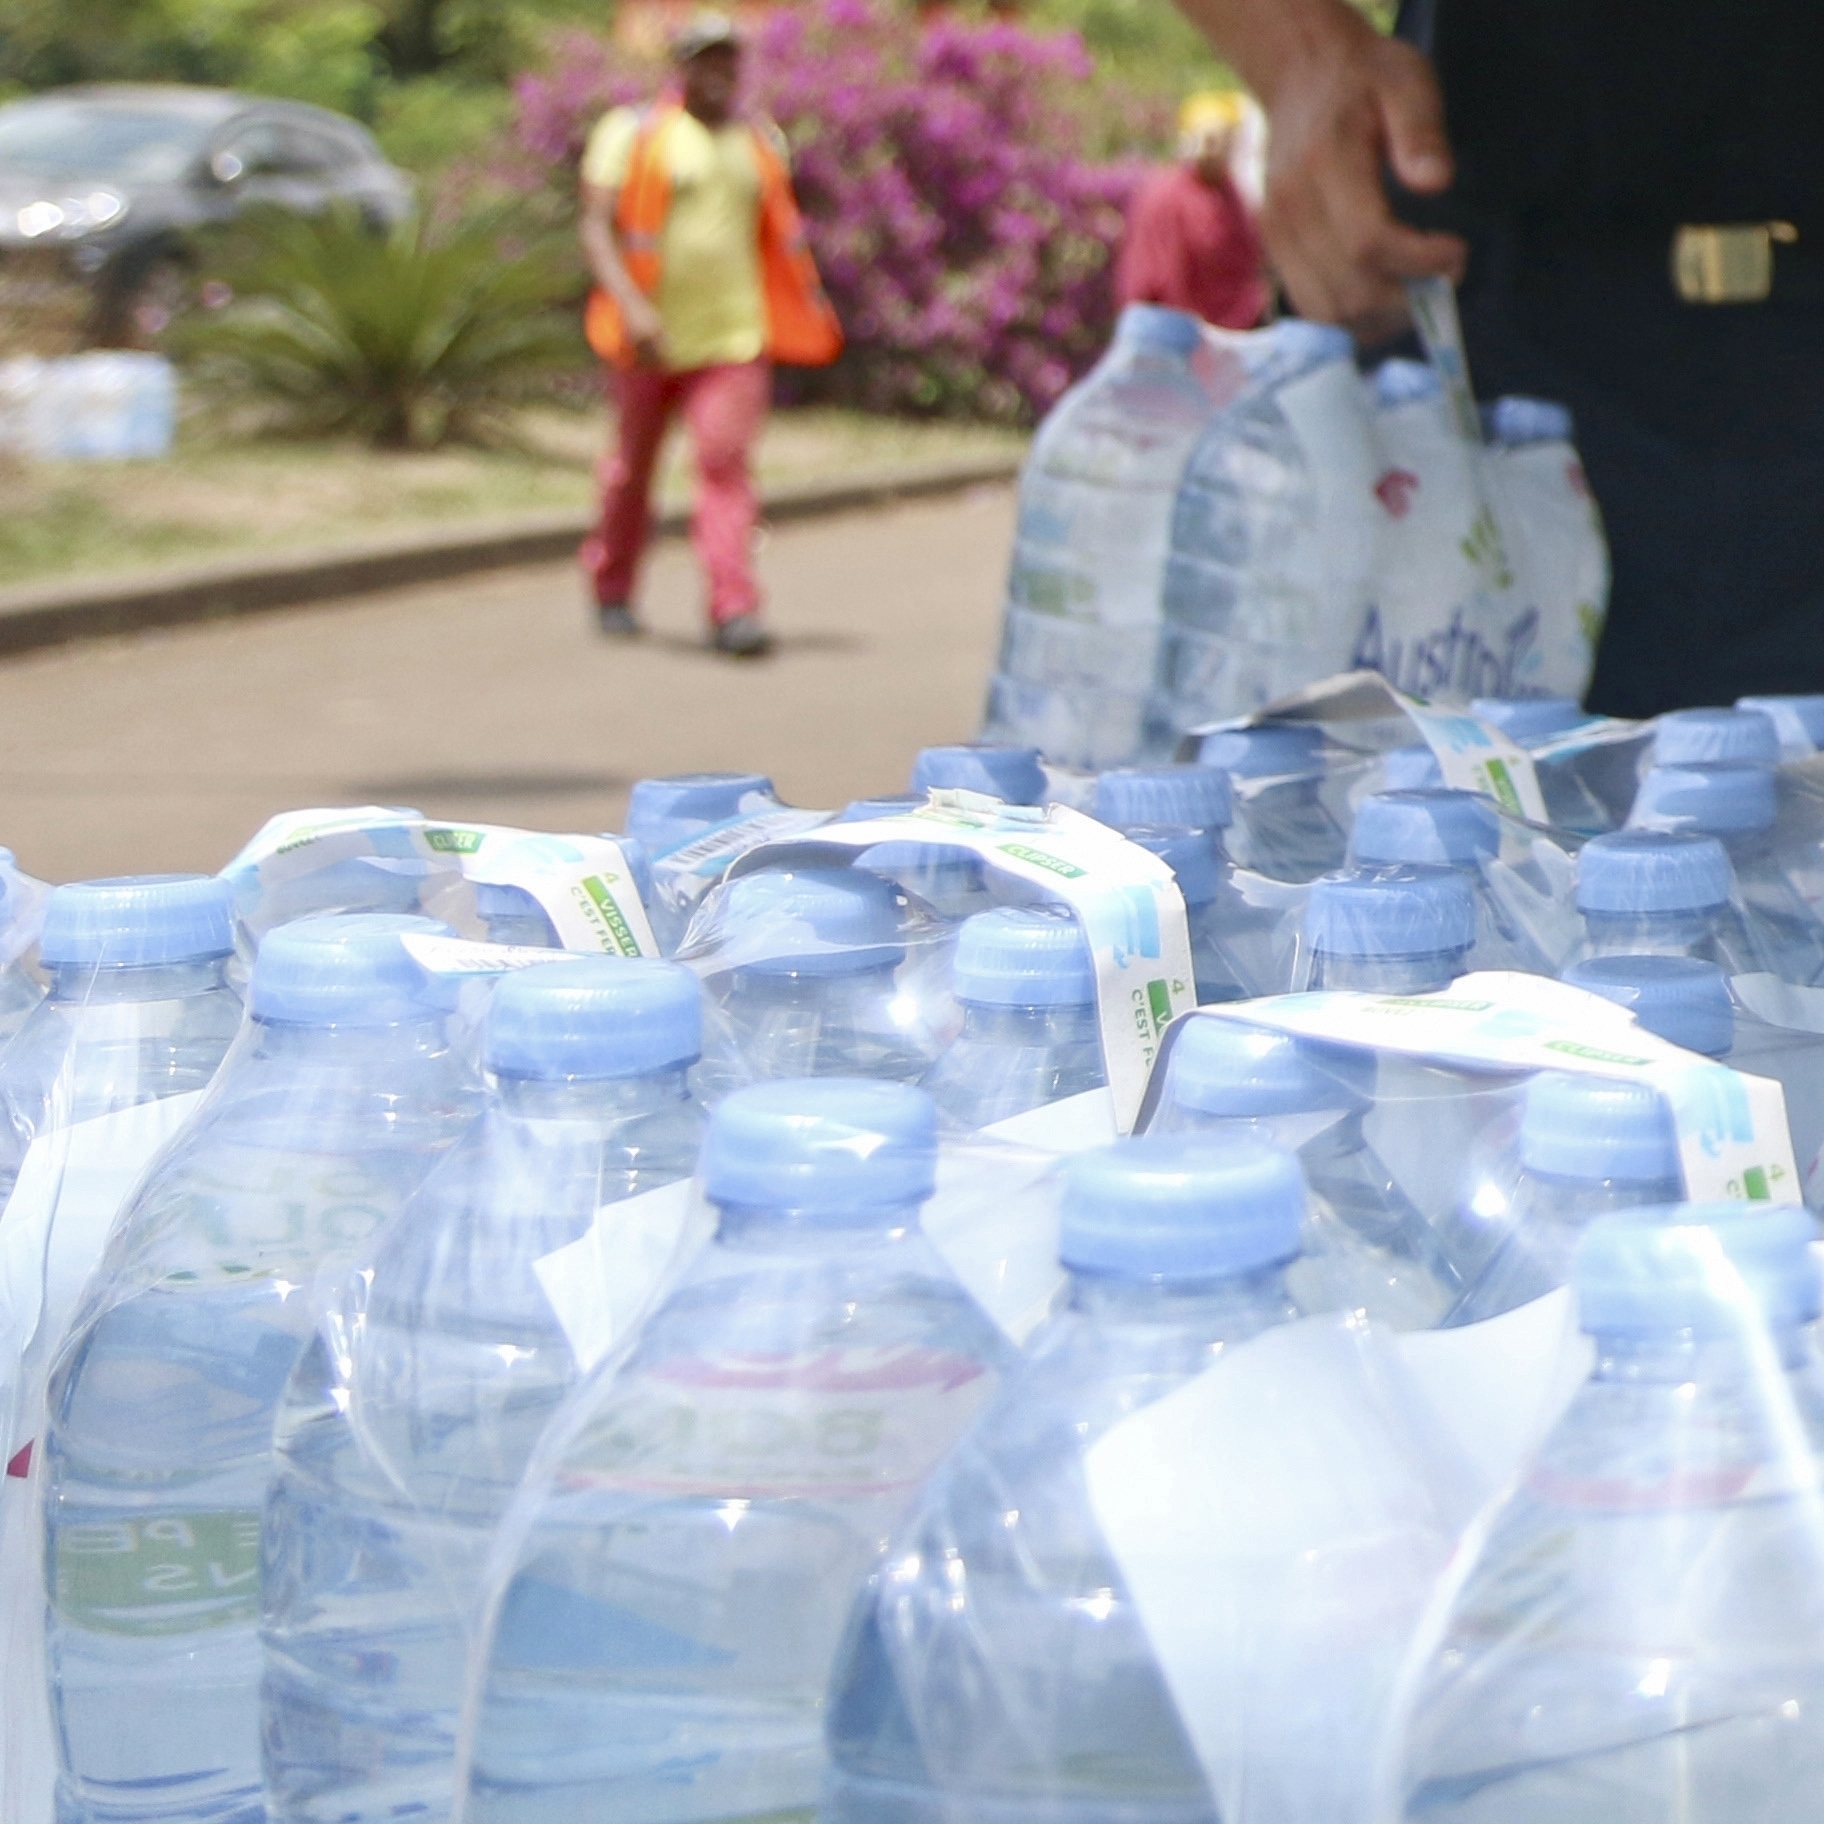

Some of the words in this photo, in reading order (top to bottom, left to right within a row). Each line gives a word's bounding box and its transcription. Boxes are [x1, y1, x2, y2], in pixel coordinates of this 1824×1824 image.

[1006, 843, 1077, 876] CLIPSER
[570, 885, 602, 925] C'EST
[600, 897, 639, 958] VISSER
[1172, 979, 1186, 995] 4
[1131, 988, 1152, 1041] C'EST
